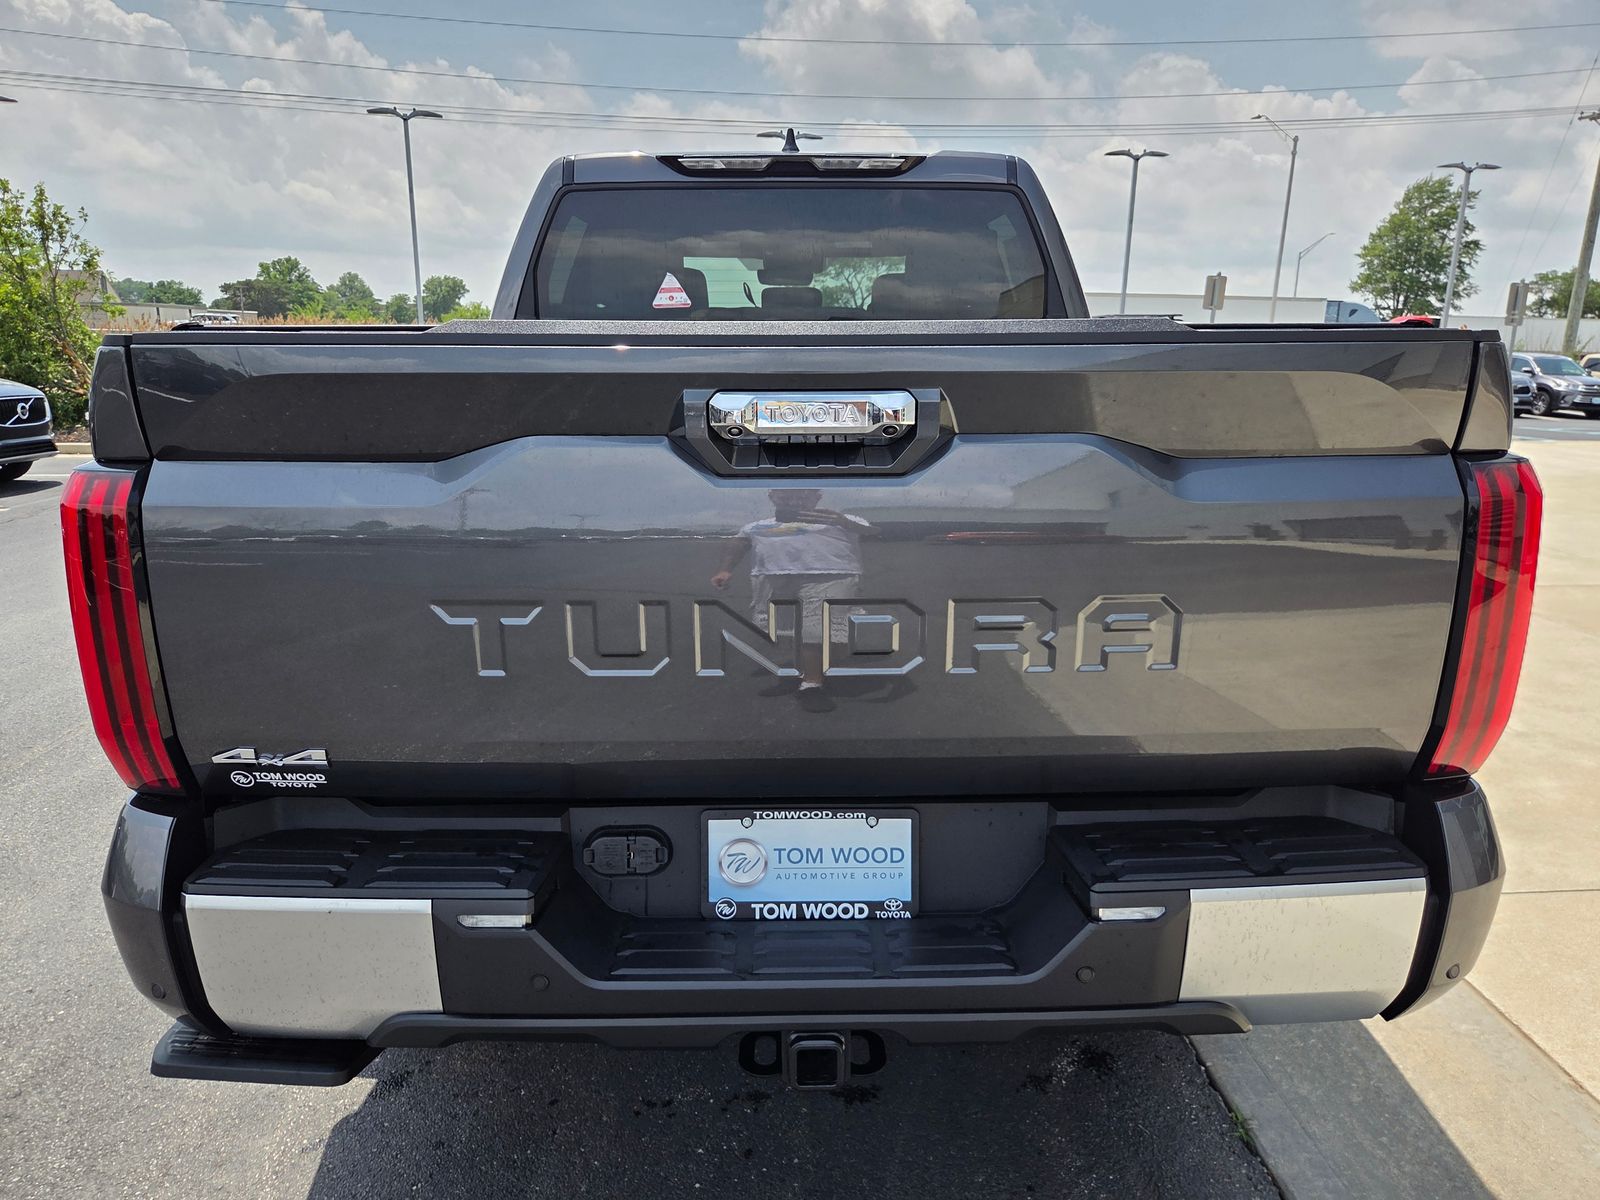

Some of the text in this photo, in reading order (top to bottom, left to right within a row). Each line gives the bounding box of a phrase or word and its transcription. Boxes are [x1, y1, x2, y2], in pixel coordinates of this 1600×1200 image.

[765, 404, 858, 423] TOYOTA
[427, 593, 1186, 678] TUNDRA
[253, 771, 326, 781] TOM WOOD
[753, 810, 867, 820] TOMWOOD.com
[773, 847, 905, 864] TOM WOOD
[775, 872, 905, 880] AUTOMOTIVE GROUP
[751, 903, 869, 920] TOM WOOD
[875, 910, 912, 919] TOYOTA
